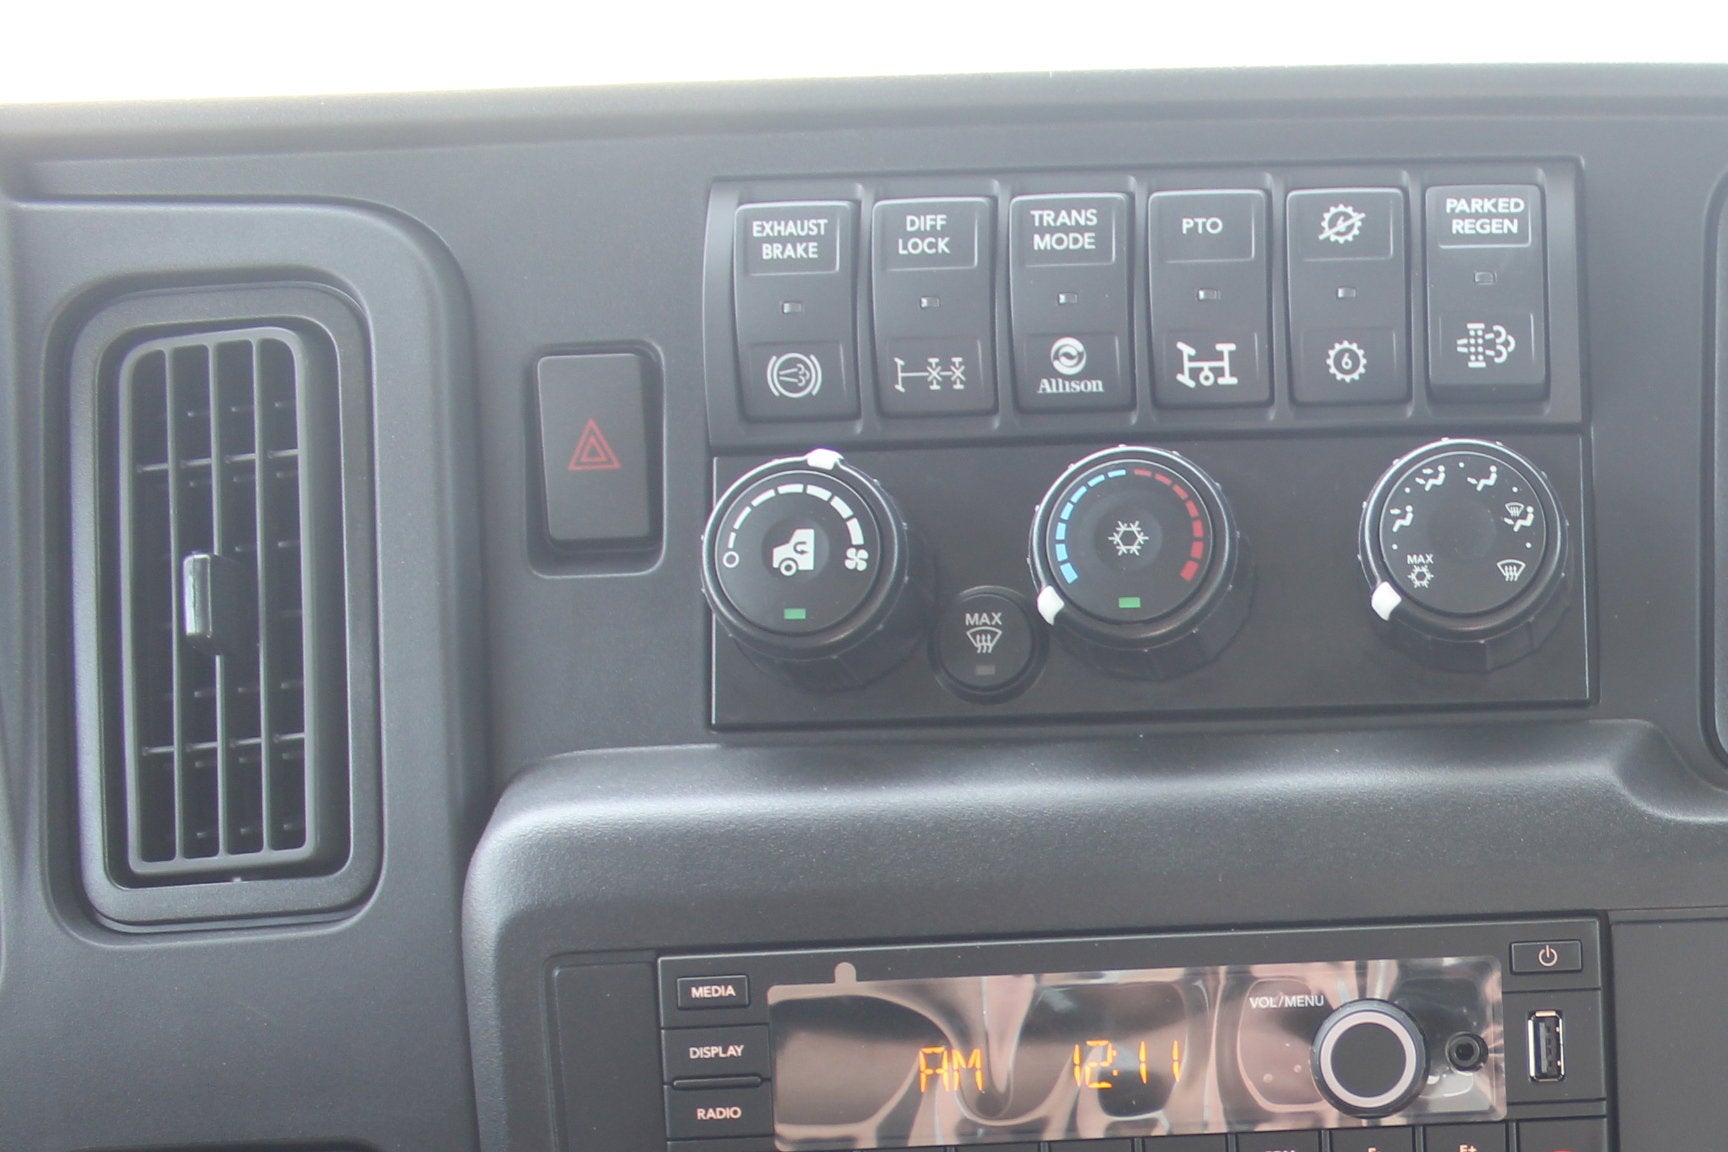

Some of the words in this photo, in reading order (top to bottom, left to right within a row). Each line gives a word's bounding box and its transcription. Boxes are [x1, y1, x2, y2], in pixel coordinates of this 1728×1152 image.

[1445, 197, 1524, 214] PARKED
[906, 214, 947, 232] DIFF
[1030, 209, 1098, 227] TRANS
[1182, 218, 1223, 234] PTO
[1451, 218, 1518, 235] REGEN
[752, 219, 828, 237] EXHAUST
[898, 237, 951, 255] LOCK
[1033, 233, 1096, 251] MODE
[762, 242, 819, 260] BRAKE
[1341, 352, 1353, 370] 6
[1038, 377, 1104, 394] Allison
[1407, 554, 1434, 565] MAX
[965, 612, 1002, 626] MAX
[691, 985, 735, 999] MEDIA
[1249, 994, 1325, 1009] VOL/MENU
[689, 1045, 744, 1060] DISPLAY
[919, 1046, 983, 1092] AM
[697, 1106, 741, 1120] RADIO
